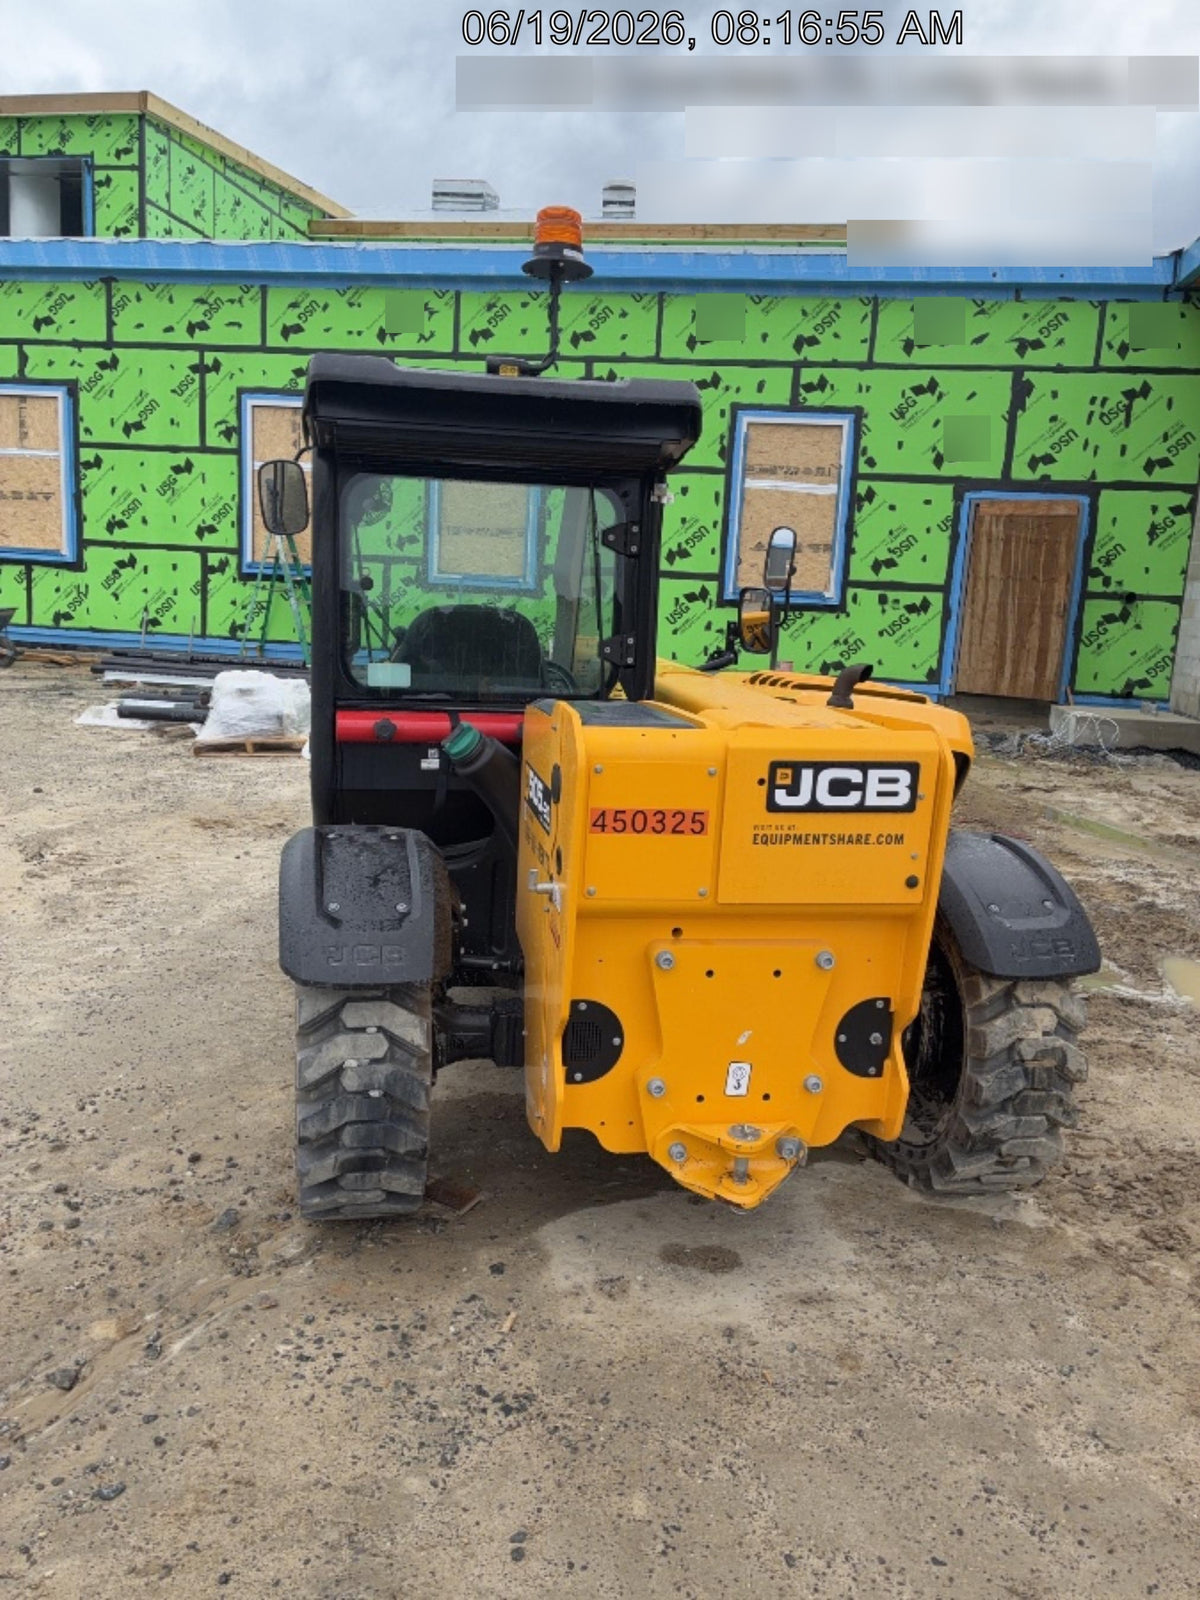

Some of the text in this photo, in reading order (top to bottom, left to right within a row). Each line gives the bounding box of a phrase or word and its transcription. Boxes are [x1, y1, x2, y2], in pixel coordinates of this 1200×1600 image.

[48, 292, 68, 316] USG
[202, 297, 225, 321] USG
[297, 299, 321, 323] USG
[487, 304, 512, 328] USG
[589, 305, 615, 328] USG
[813, 310, 841, 335] USG
[1038, 312, 1066, 339] USG
[83, 370, 103, 393] USG
[175, 375, 195, 397] USG
[138, 399, 160, 421] USG
[889, 396, 918, 422] USG
[1050, 428, 1079, 454] USG
[1166, 430, 1196, 457] USG
[157, 474, 178, 496] USG
[121, 498, 143, 520] USG
[211, 502, 233, 524] USG
[936, 514, 953, 533] US
[685, 525, 710, 548] USG
[891, 533, 918, 558] USG
[13, 568, 27, 585] US
[190, 578, 201, 596] US
[66, 589, 87, 612] USG
[155, 596, 176, 618] USG
[665, 601, 690, 626] USG
[883, 614, 911, 638] USG
[1080, 625, 1108, 648] USG
[839, 636, 866, 661] USG
[1146, 654, 1174, 679] USG
[774, 768, 911, 806] JCB
[592, 810, 705, 834] 450325
[752, 834, 904, 846] EQUIPMENTSHARE.COM
